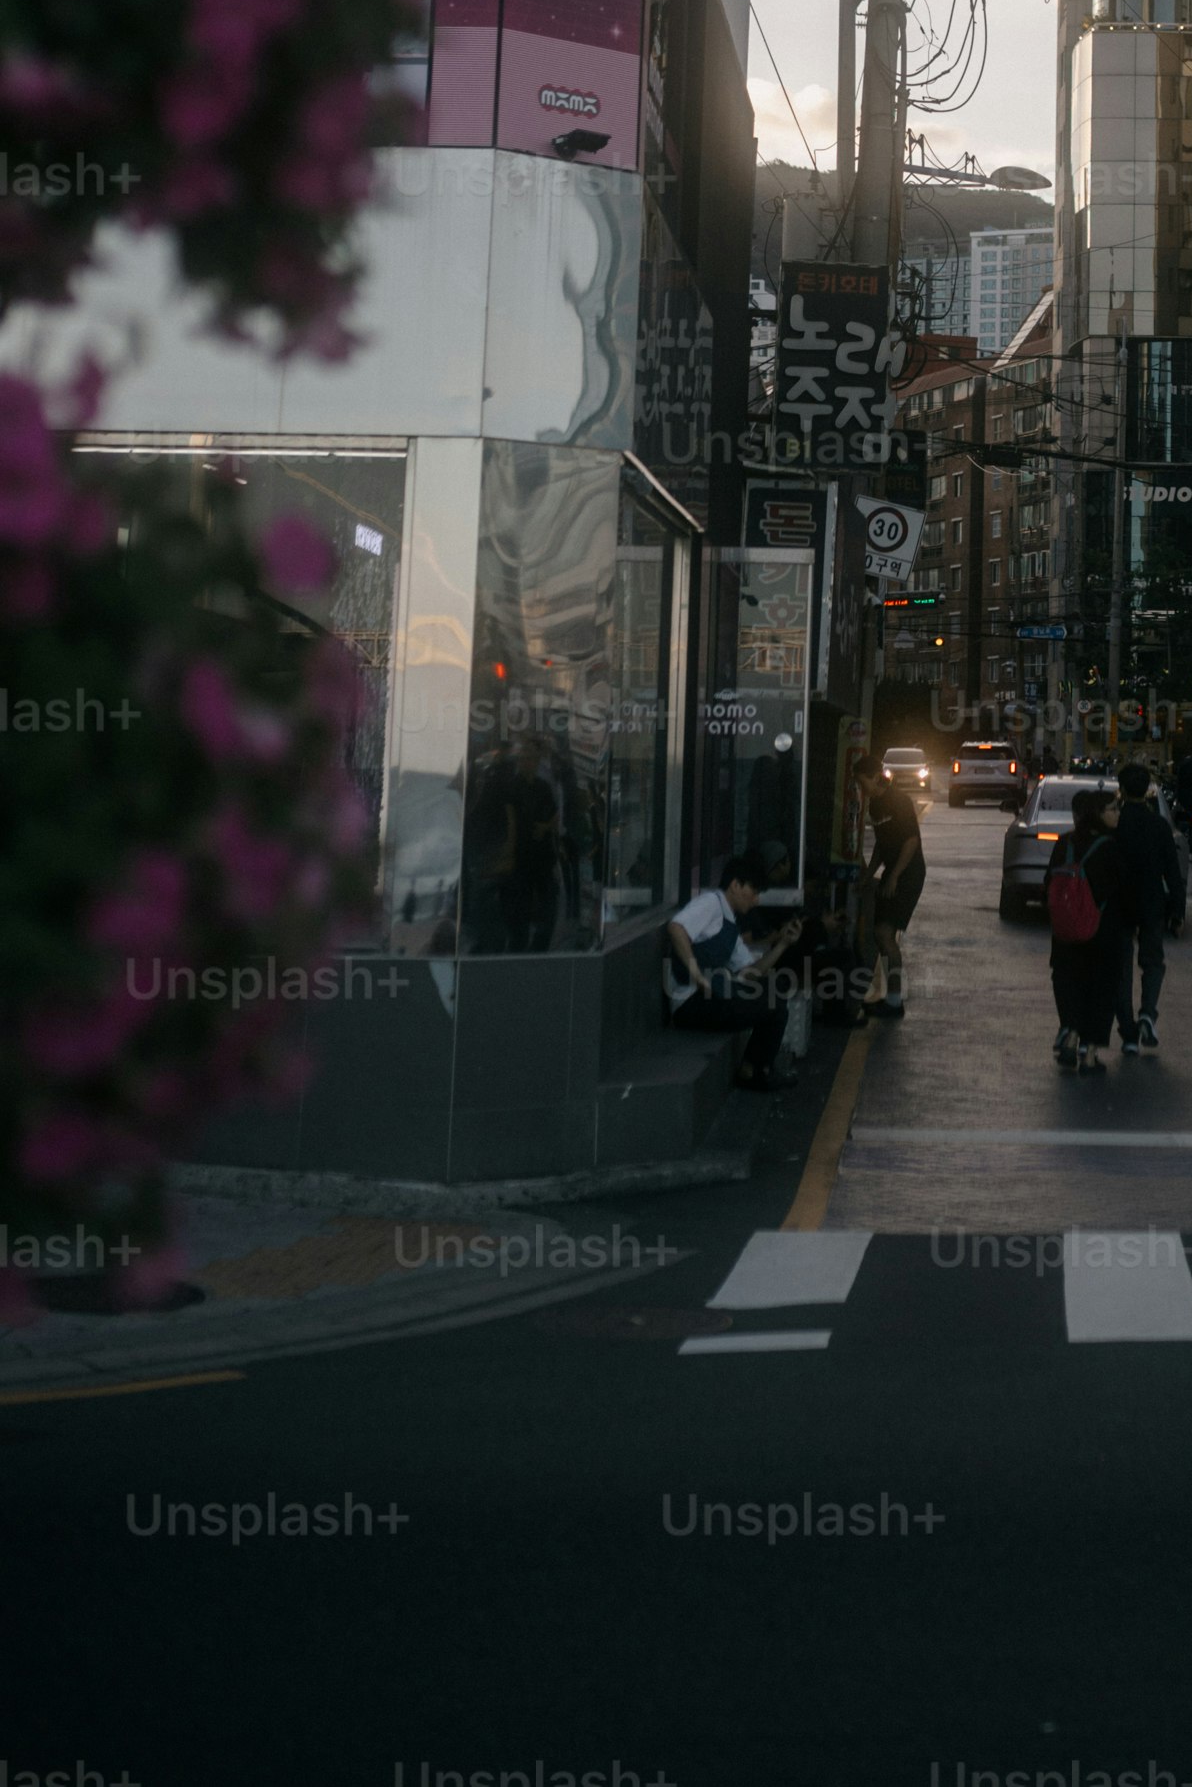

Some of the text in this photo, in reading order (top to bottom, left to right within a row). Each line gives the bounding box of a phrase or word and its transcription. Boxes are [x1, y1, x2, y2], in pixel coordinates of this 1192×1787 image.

[796, 271, 879, 296] 돈키호테
[781, 293, 907, 378] 노래
[778, 365, 897, 463] 주점
[785, 436, 812, 460] B1
[873, 519, 899, 541] 30
[864, 554, 902, 577] 0 구역
